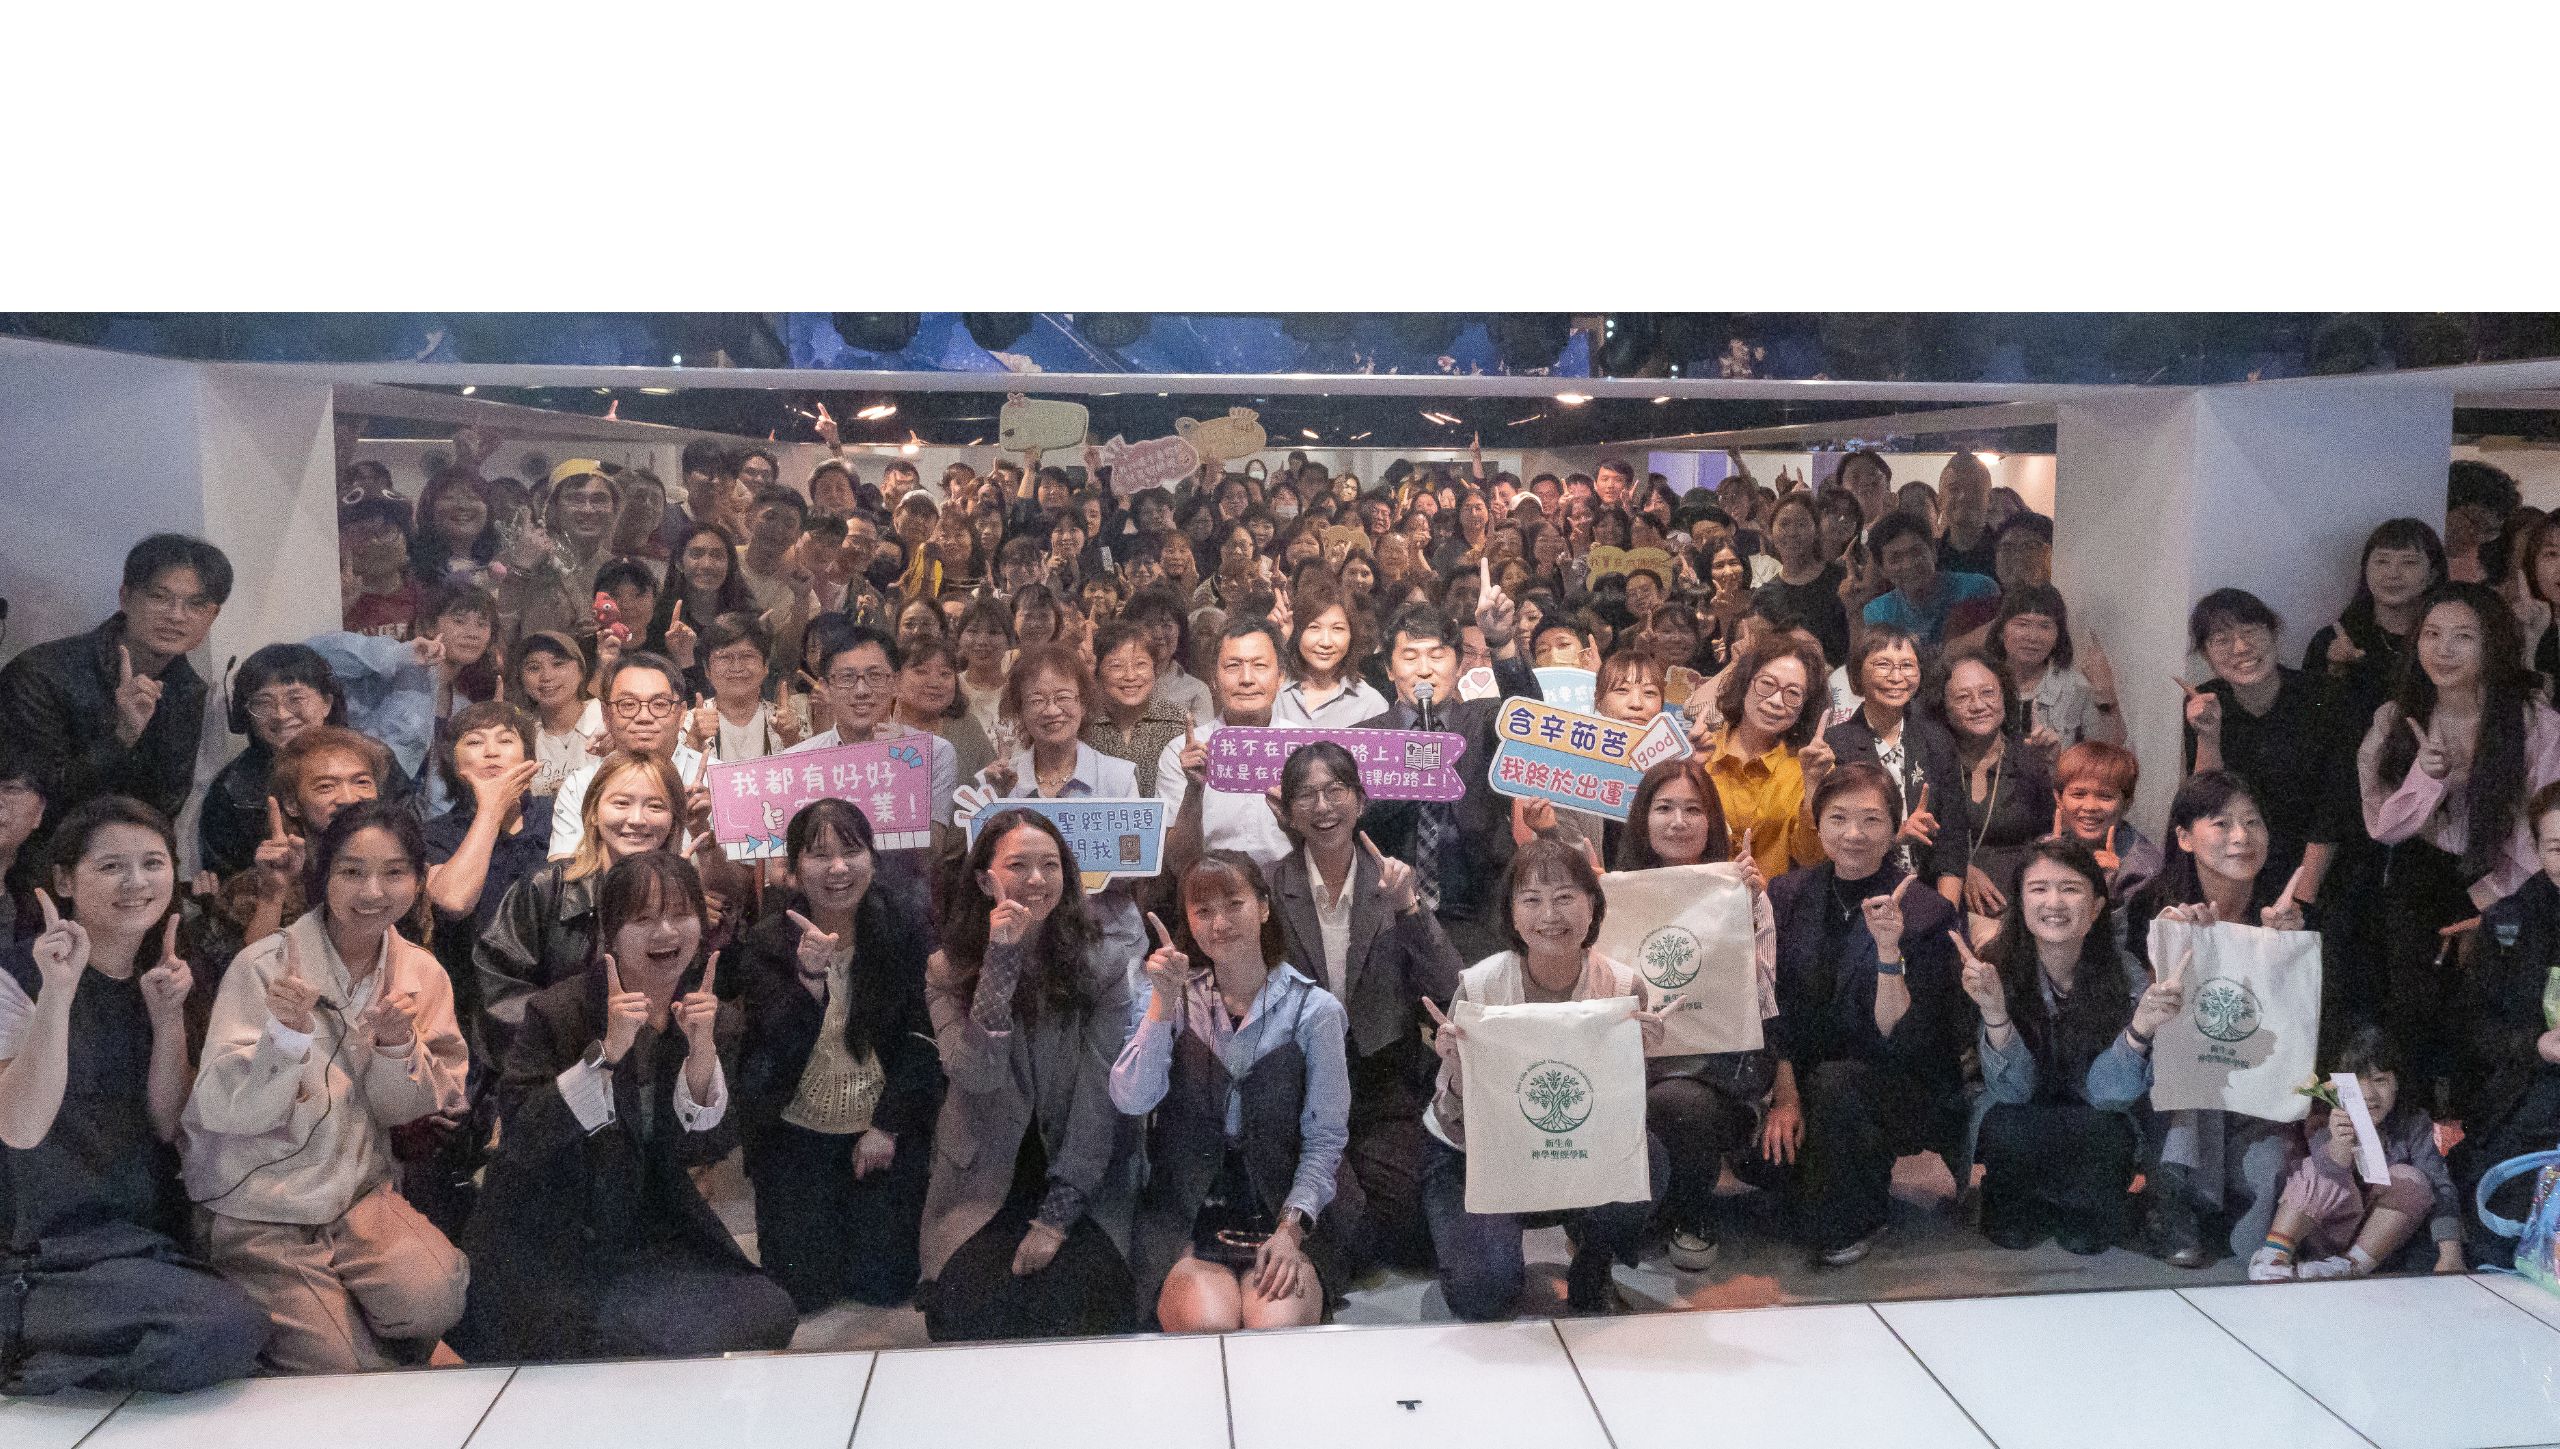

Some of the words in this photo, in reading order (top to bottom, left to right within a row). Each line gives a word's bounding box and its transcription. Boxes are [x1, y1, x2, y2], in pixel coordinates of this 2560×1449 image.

[1220, 738, 1400, 764] 我不在回路上，
[1508, 707, 1629, 759] 含辛茹苦
[1637, 732, 1675, 767] good
[730, 761, 897, 798] 我都有好好
[1500, 756, 1639, 807] 我終於出運
[1049, 808, 1156, 835] 聖經問題
